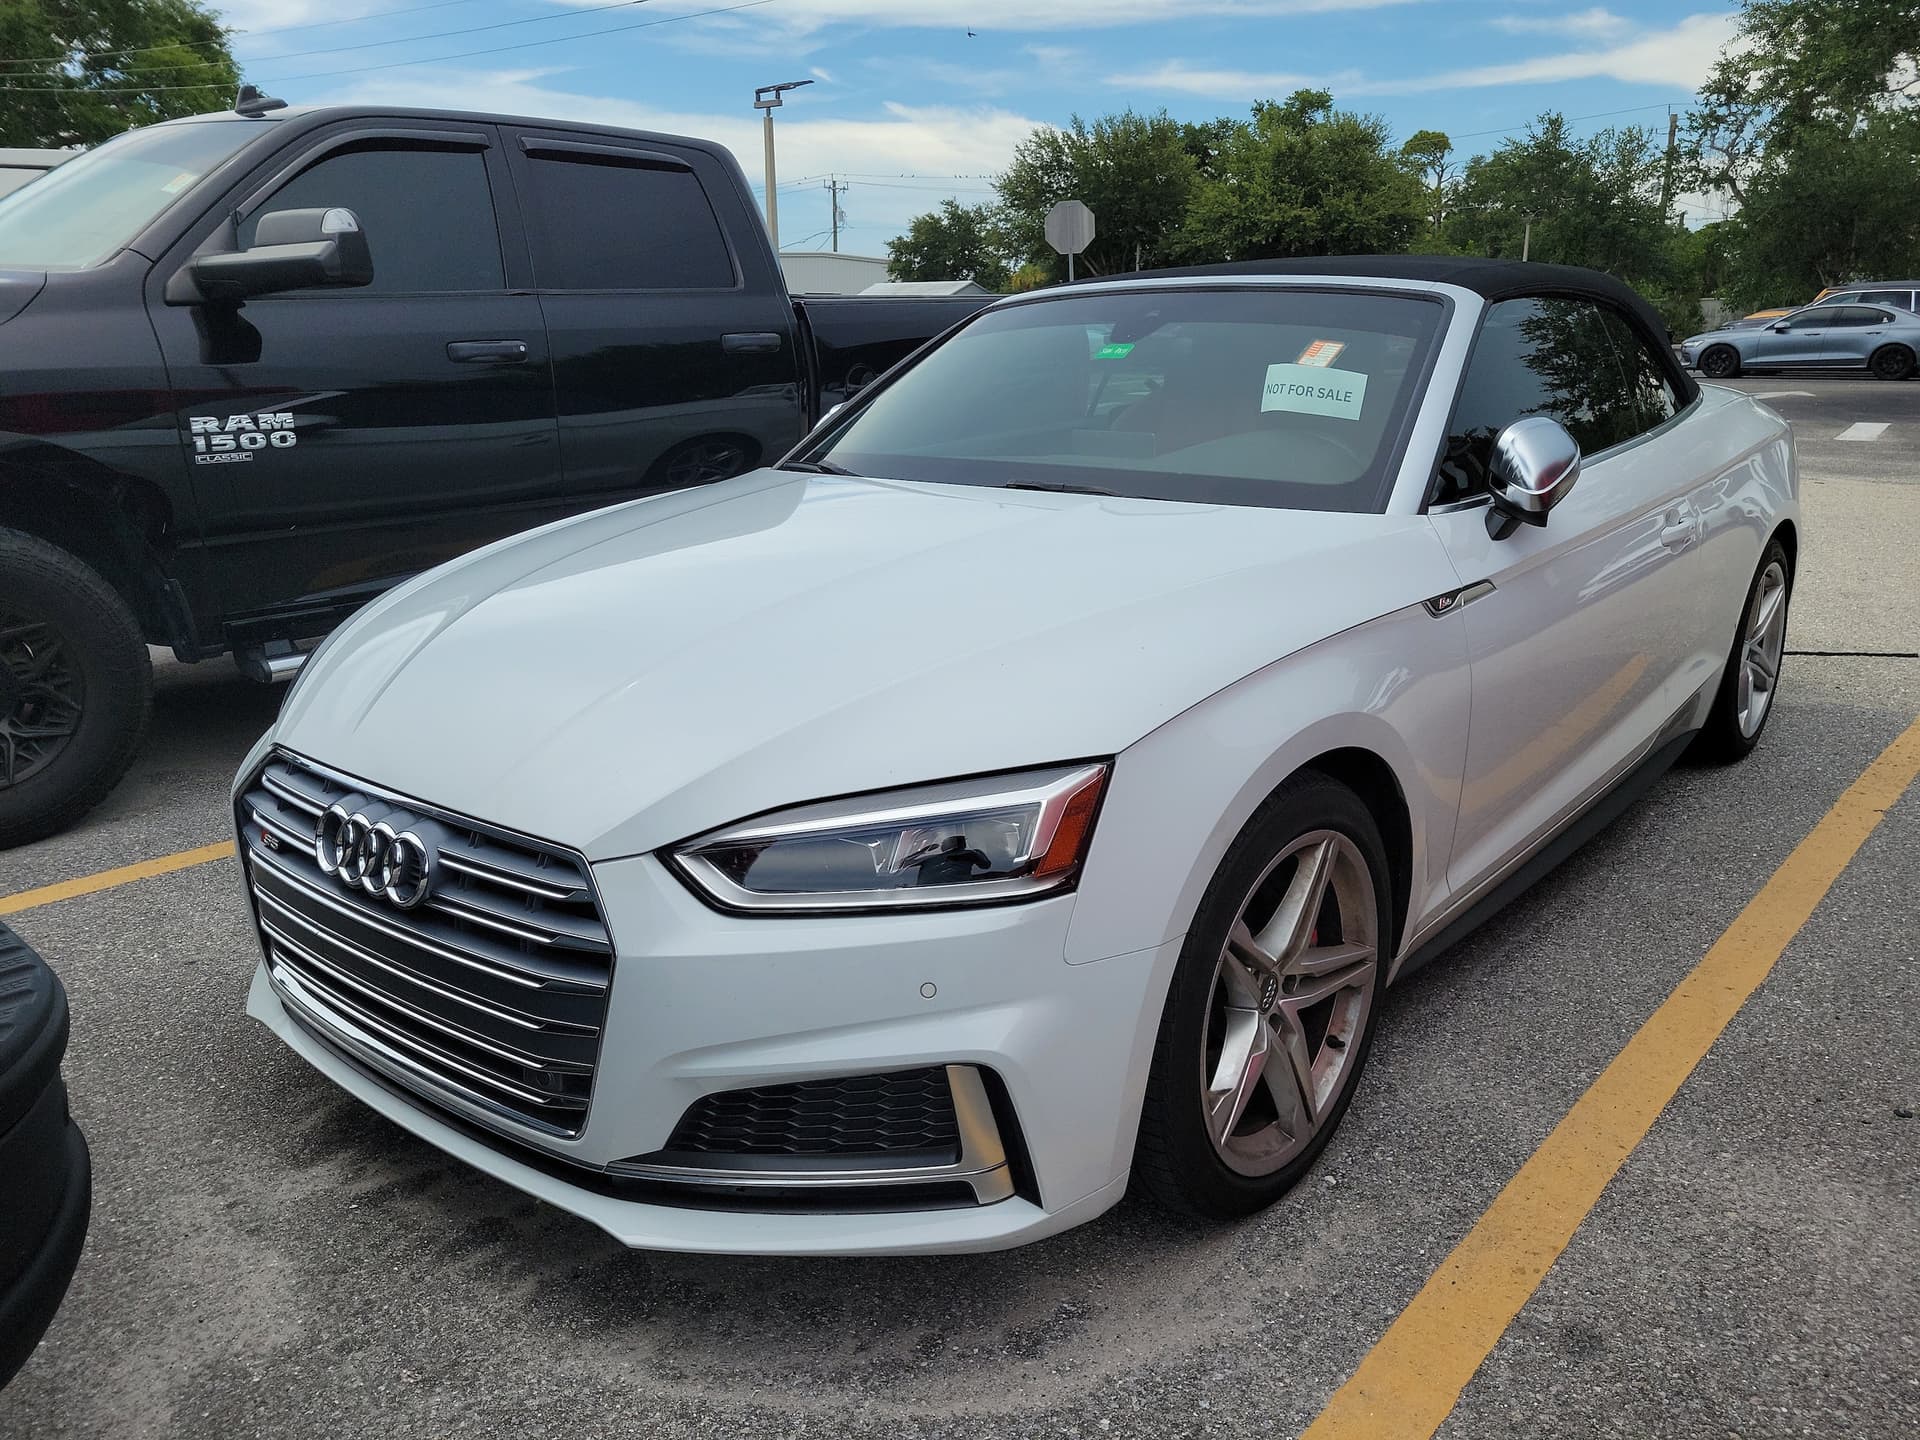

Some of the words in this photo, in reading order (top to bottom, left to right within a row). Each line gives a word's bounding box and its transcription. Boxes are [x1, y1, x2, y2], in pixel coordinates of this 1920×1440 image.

[1266, 383, 1286, 395] NOT
[1288, 384, 1314, 397] FOR
[1317, 387, 1353, 403] SALE
[189, 412, 295, 433] RAM
[192, 430, 297, 452] 1500
[197, 453, 252, 463] CLASSIC
